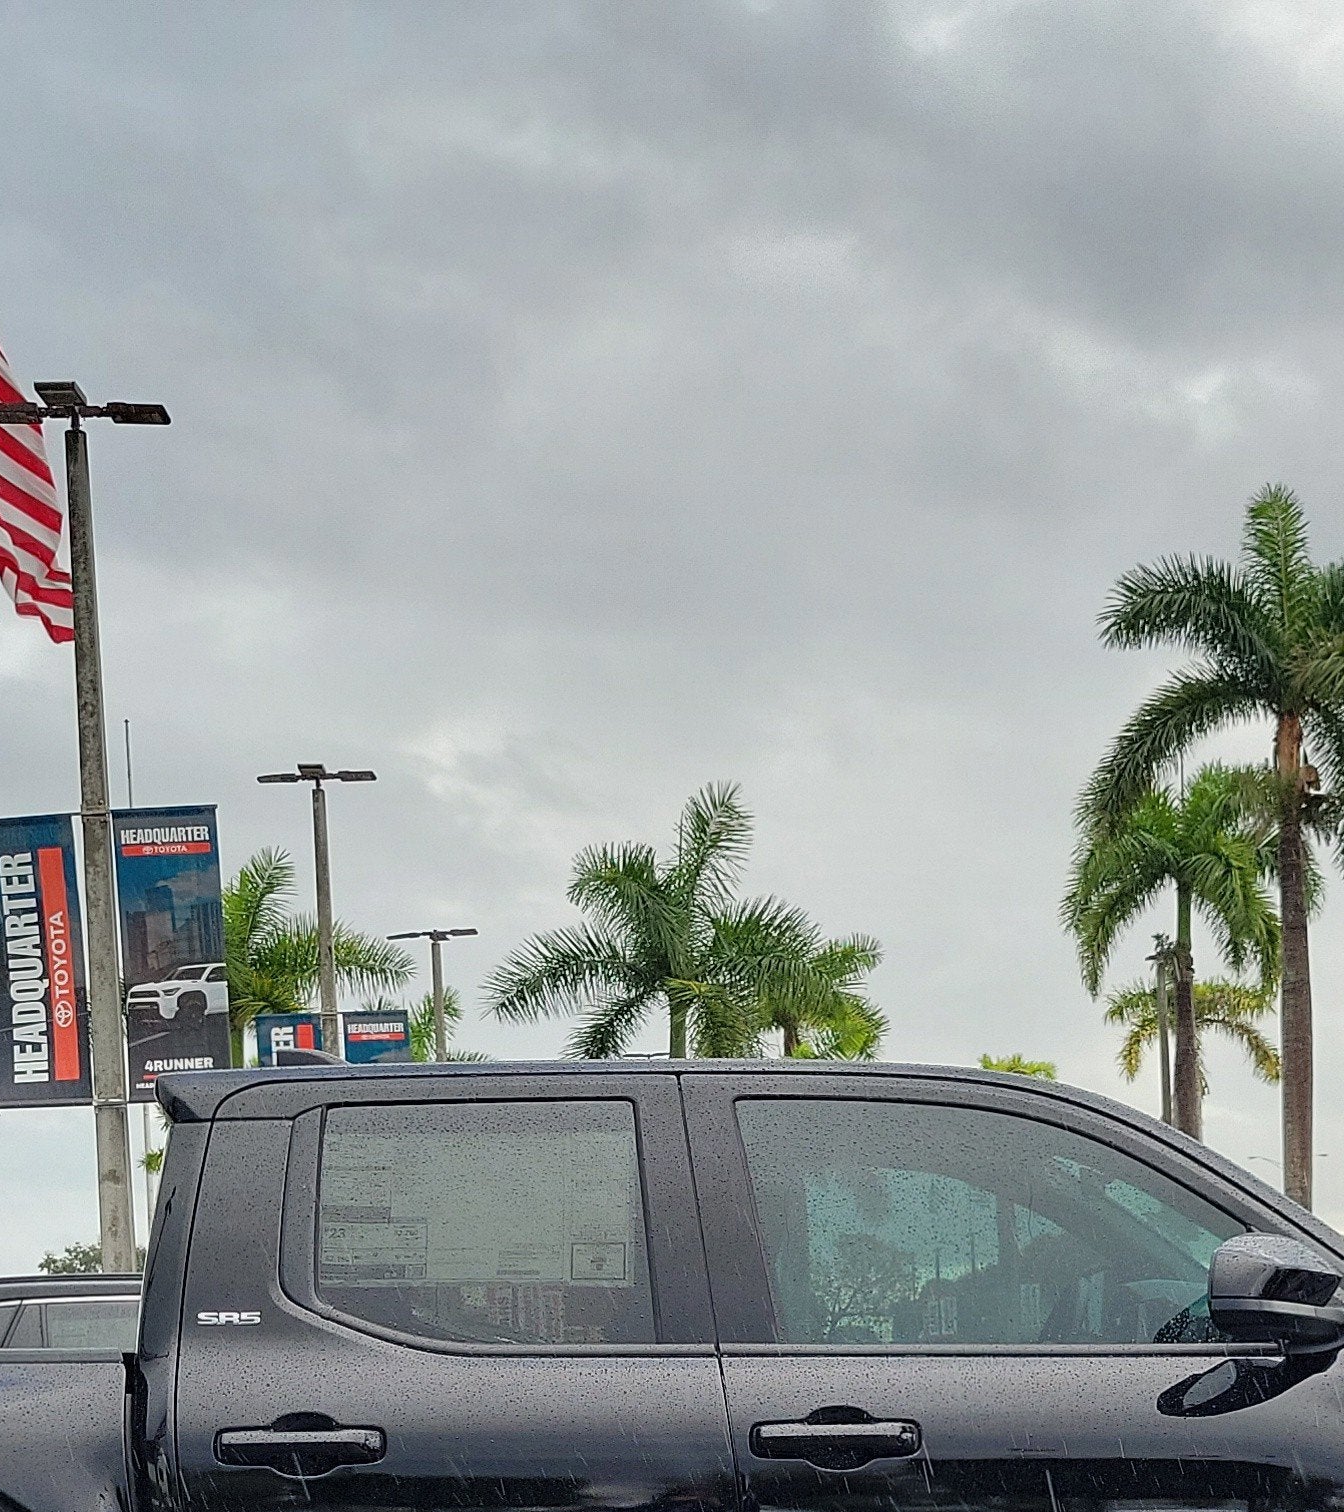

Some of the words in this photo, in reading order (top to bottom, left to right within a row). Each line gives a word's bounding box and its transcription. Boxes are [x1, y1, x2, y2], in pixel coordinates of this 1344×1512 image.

[120, 826, 210, 845] HEADQUARTER
[154, 845, 188, 853] TOYOTA
[49, 911, 70, 999] TOYOTA
[347, 1023, 404, 1034] HEADQUARTER
[144, 1057, 214, 1071] 4RUNNER
